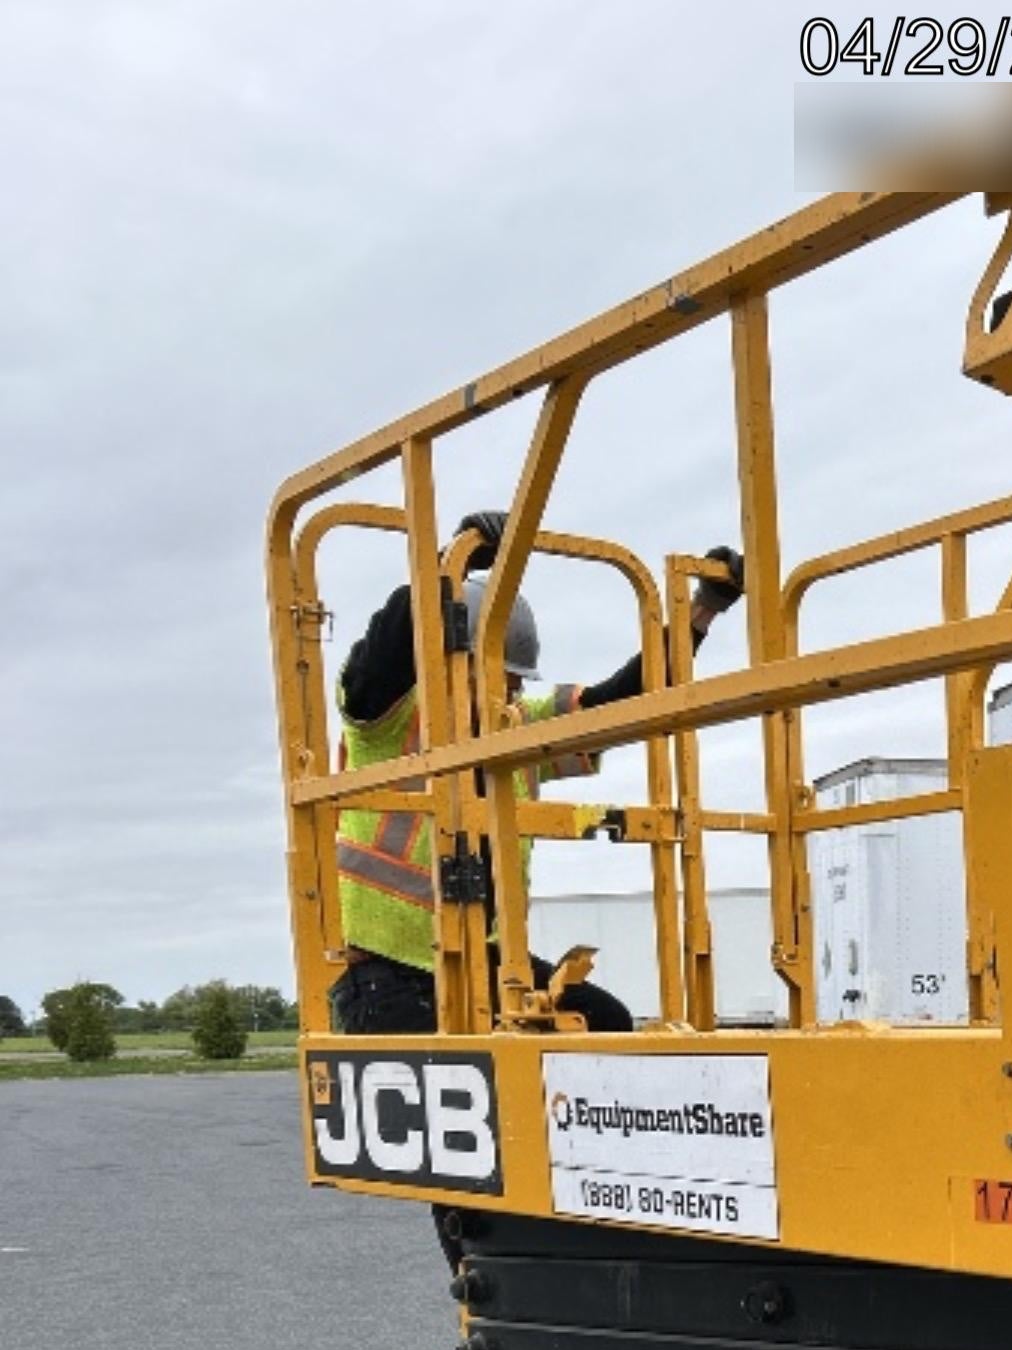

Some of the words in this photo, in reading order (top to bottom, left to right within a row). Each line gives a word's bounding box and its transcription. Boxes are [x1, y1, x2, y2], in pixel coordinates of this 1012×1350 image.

[313, 1060, 497, 1180] JCB
[574, 1096, 765, 1138] EquipmentShare
[580, 1178, 632, 1214] (888)
[638, 1186, 740, 1223] 80-RENTS
